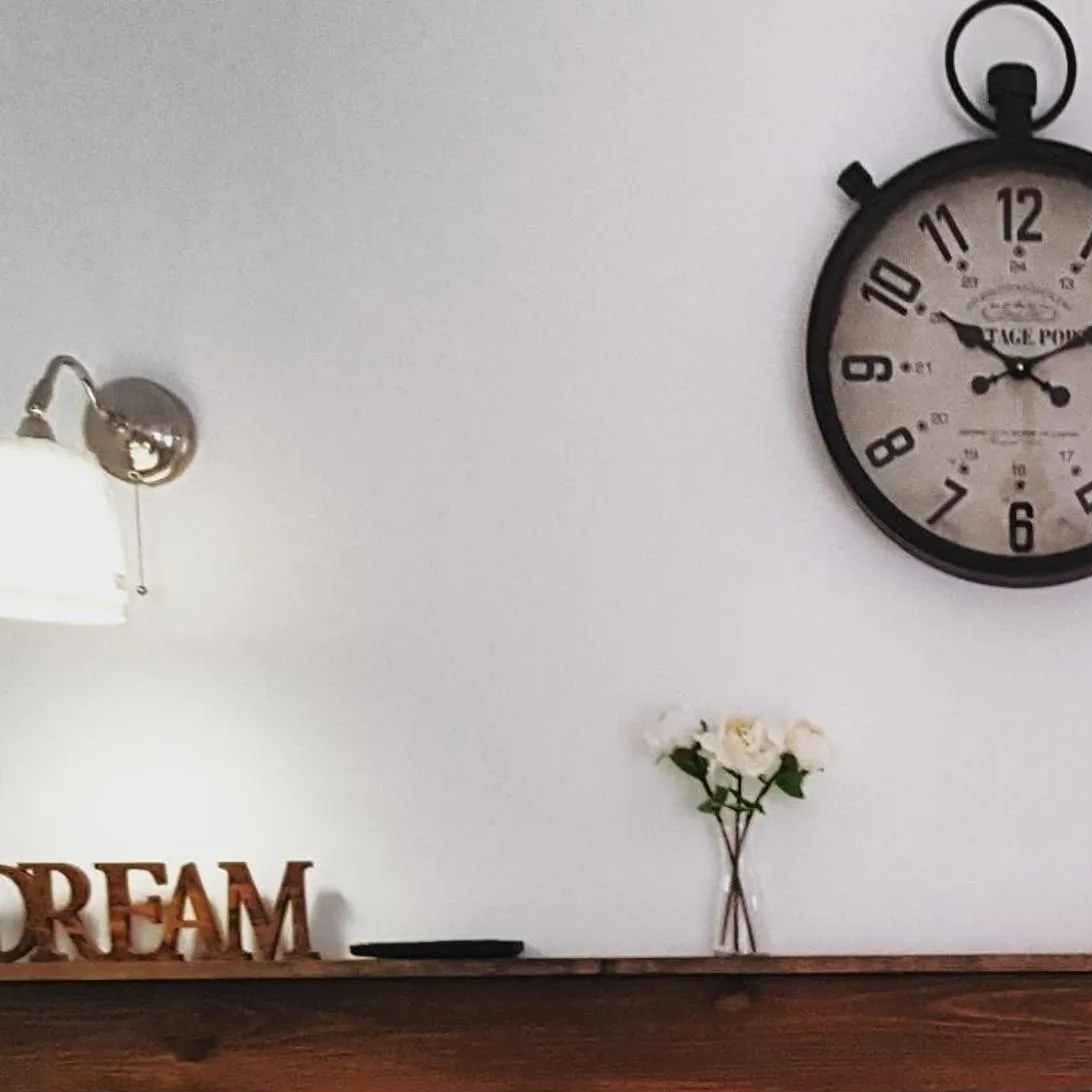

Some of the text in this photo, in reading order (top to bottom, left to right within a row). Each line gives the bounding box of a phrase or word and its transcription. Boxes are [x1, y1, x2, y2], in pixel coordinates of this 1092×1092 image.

[918, 203, 969, 263] 11
[996, 187, 1043, 242] 12
[860, 256, 922, 317] 10
[841, 354, 893, 383] 9
[864, 425, 916, 469] 8
[925, 476, 969, 526] 7
[1008, 500, 1035, 554] 6
